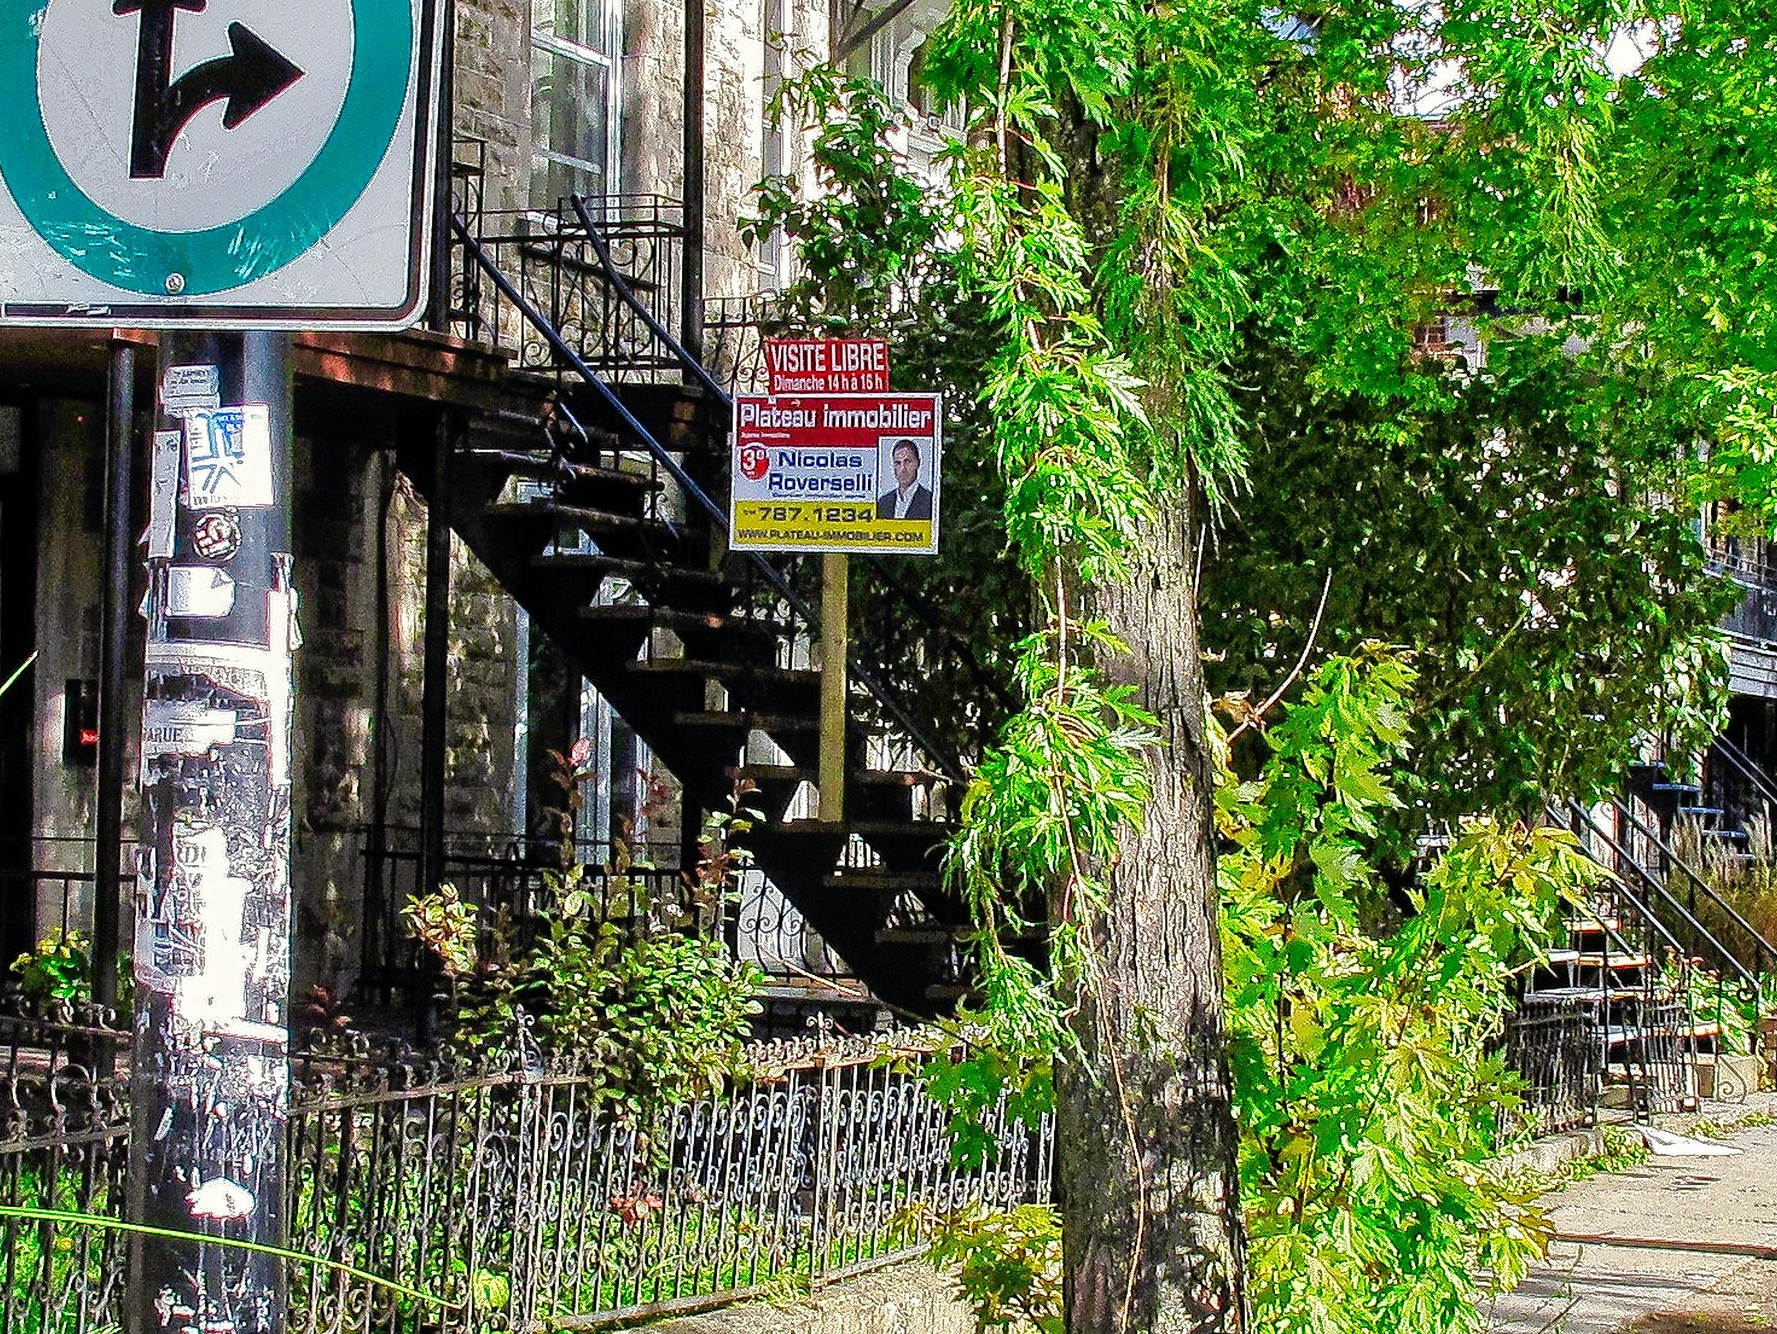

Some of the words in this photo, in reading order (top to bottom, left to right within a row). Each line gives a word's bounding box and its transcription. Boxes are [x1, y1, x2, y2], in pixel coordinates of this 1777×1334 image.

[771, 344, 826, 373] VISITE
[831, 343, 886, 372] LIBRE
[774, 375, 825, 391] Dimanche
[827, 375, 840, 391] 14
[860, 374, 873, 391] 16
[740, 404, 817, 428] Plateau
[823, 403, 932, 429] immobilier
[778, 451, 862, 468] Nicolas
[768, 472, 872, 492] Roverselli
[758, 506, 873, 524] 787.1234
